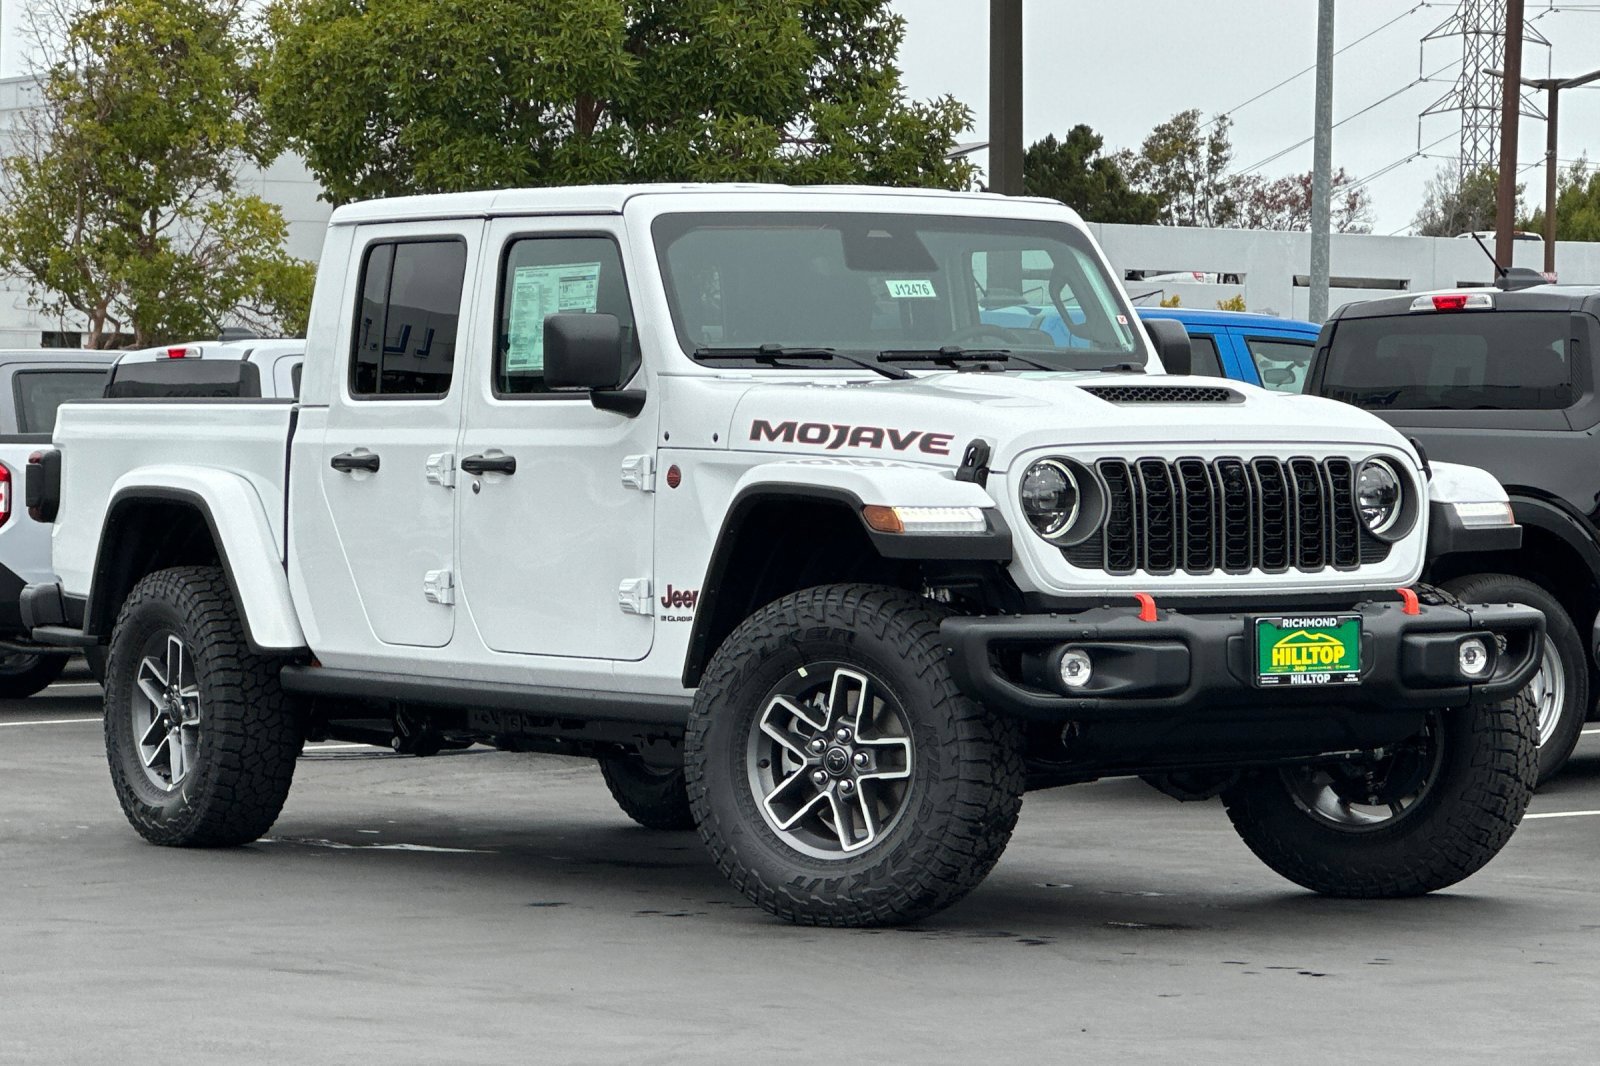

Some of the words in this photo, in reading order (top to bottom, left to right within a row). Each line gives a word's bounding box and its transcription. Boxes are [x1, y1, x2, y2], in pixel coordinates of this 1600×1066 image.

[895, 283, 930, 296] J12476
[749, 419, 955, 456] MOJAVE
[1282, 618, 1337, 628] RICHMOND
[1272, 645, 1345, 667] HILLTOP
[1290, 674, 1331, 685] HILLTOP
